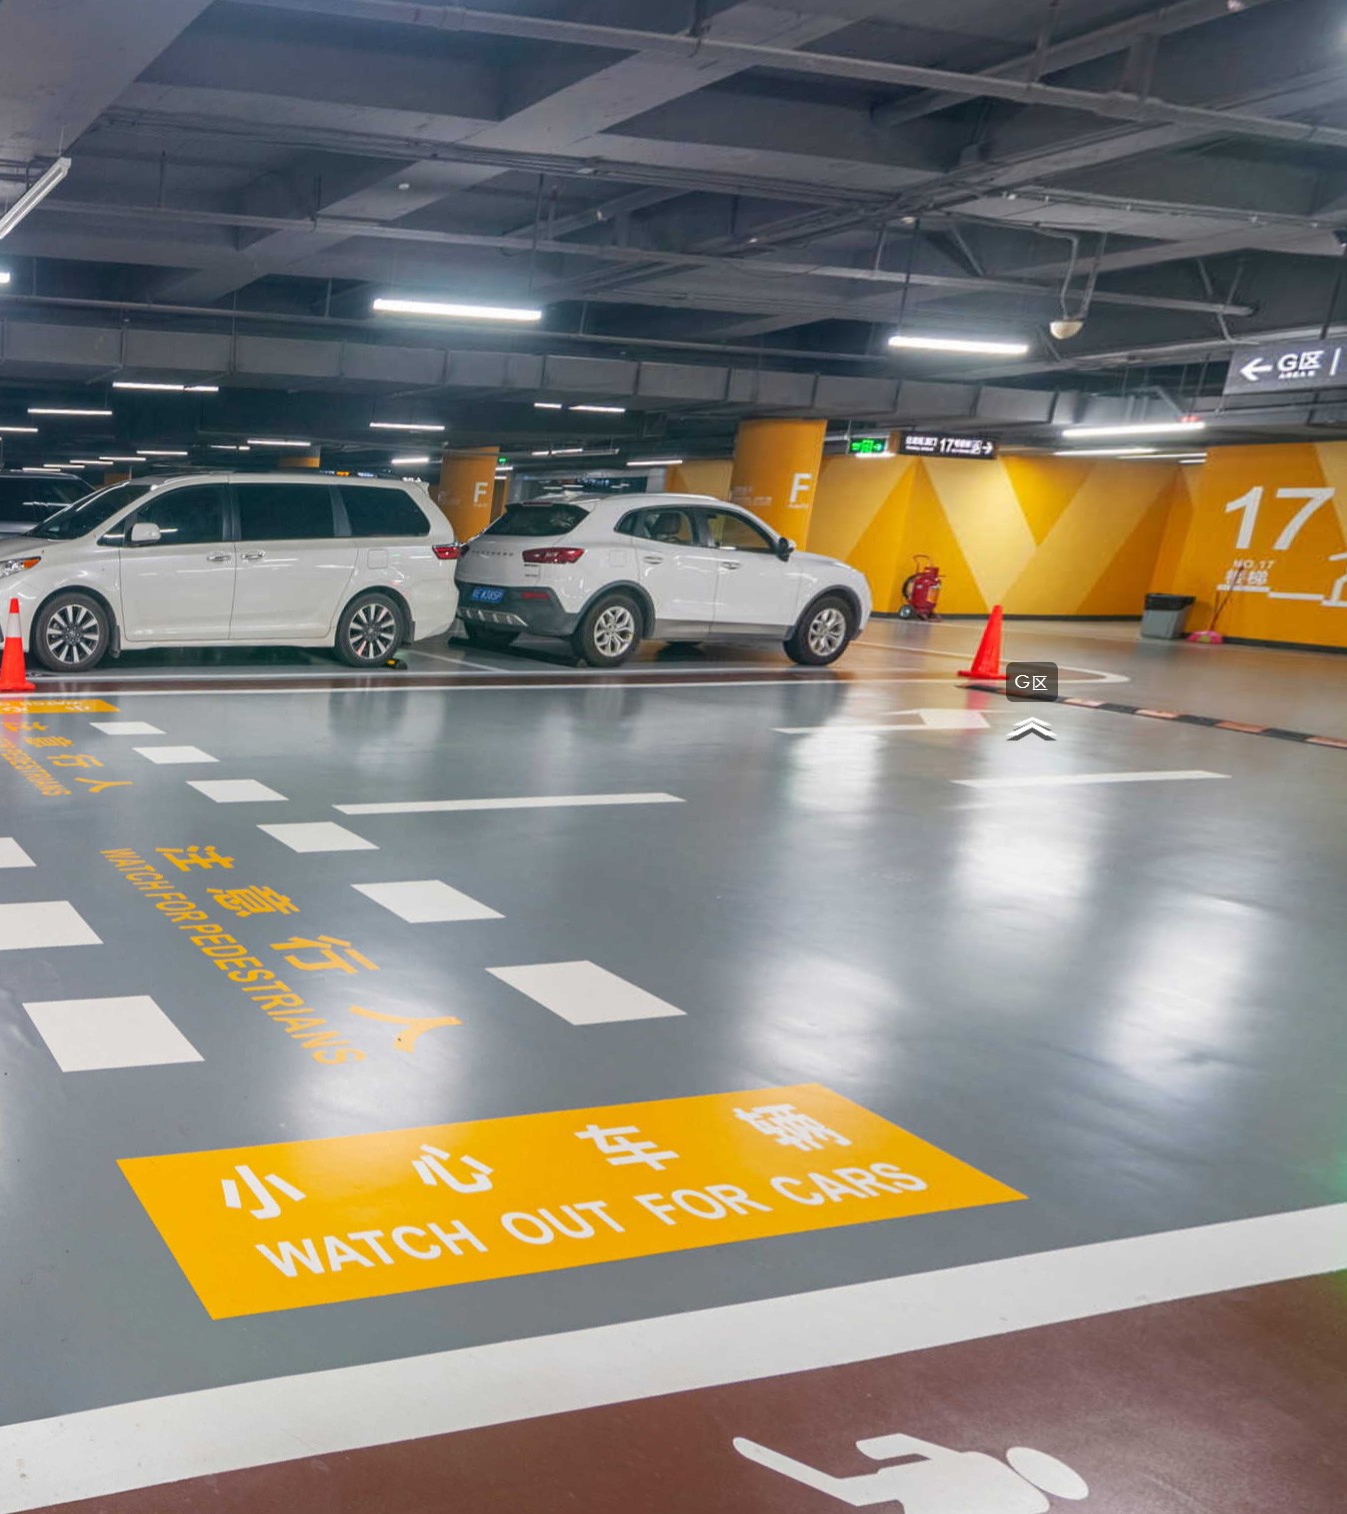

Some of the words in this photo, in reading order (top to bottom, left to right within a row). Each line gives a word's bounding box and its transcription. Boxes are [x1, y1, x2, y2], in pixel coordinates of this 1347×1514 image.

[1277, 350, 1325, 372] G区
[473, 482, 489, 503] F
[789, 473, 812, 503] F
[1225, 486, 1335, 550] 17
[100, 848, 175, 891] WATCH
[145, 892, 208, 923] FOR
[179, 923, 367, 1065] PEDESTRIANS
[155, 845, 463, 1053] 注意行人
[221, 1104, 852, 1220] 小心车辆
[256, 1220, 489, 1278] WATCH
[500, 1200, 626, 1245] OUT
[634, 1184, 773, 1225] FOR
[770, 1162, 929, 1206] CARS
